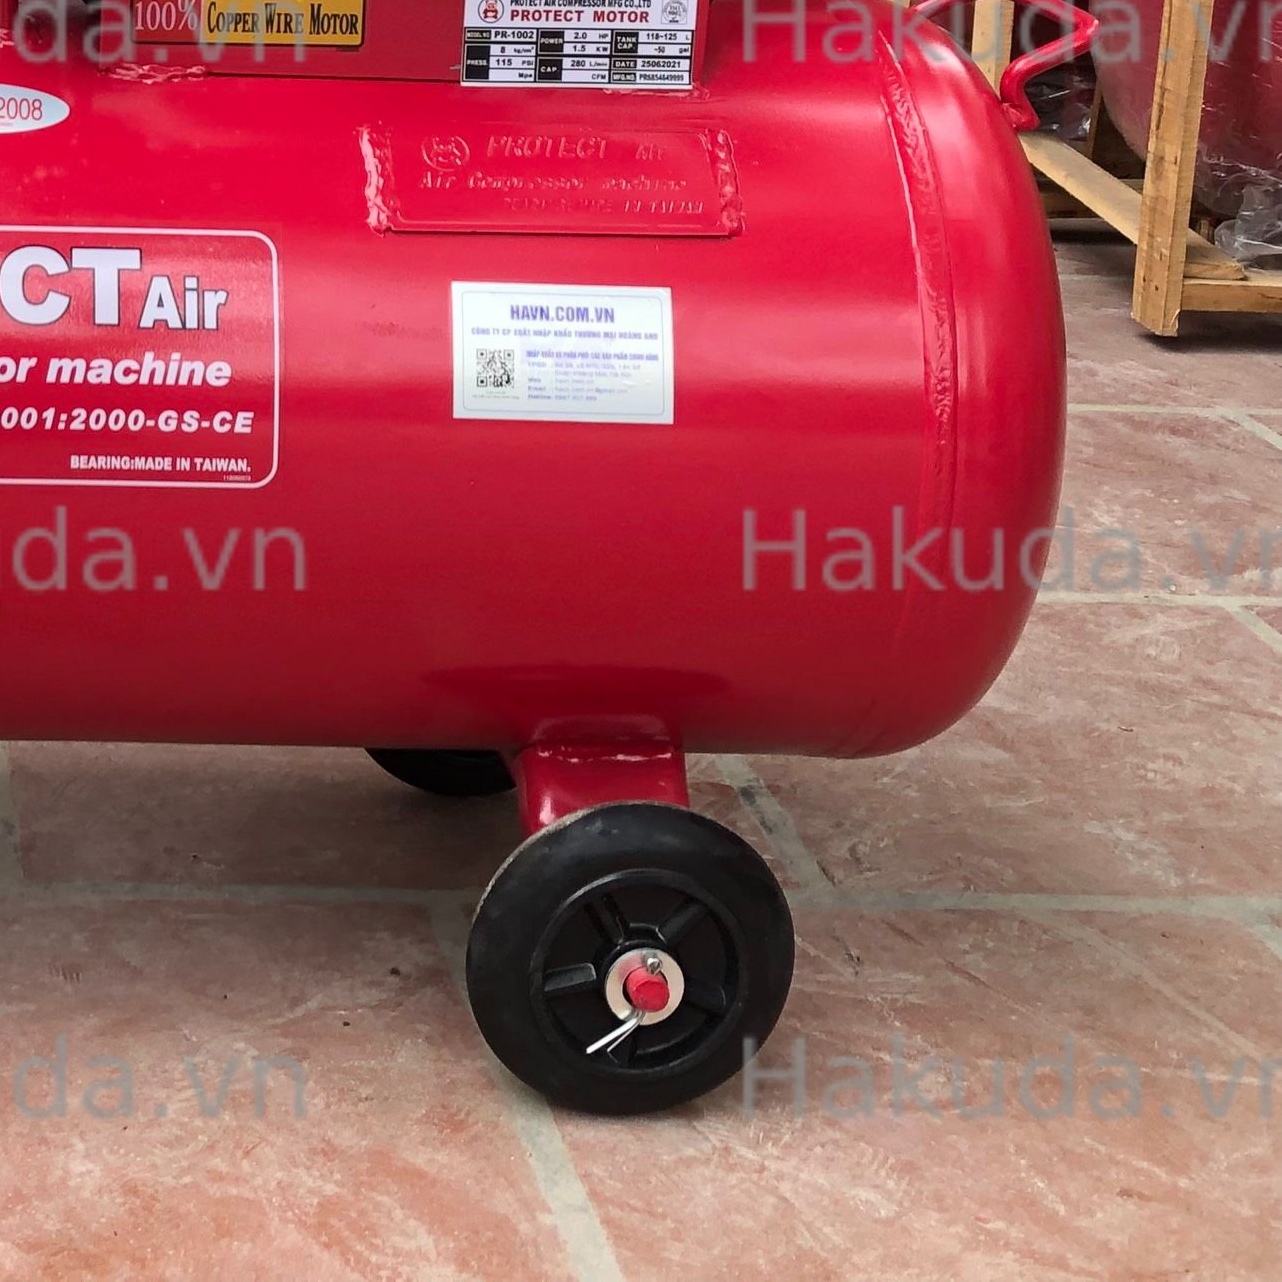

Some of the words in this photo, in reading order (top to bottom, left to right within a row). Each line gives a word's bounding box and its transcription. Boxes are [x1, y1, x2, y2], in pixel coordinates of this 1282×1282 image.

[607, 0, 623, 8] MFG
[207, 1, 260, 34] COPPER
[265, 2, 304, 34] WIRE
[309, 3, 359, 35] MOTOR
[510, 10, 585, 22] PROTECT
[593, 10, 650, 23] MOTOR
[494, 30, 535, 39] PR-1002
[574, 31, 588, 39] 2.0
[500, 46, 506, 54] 8
[495, 58, 513, 66] 115
[641, 60, 681, 68] 25062021
[486, 135, 607, 159] PROTECT
[139, 274, 228, 330] Air
[509, 304, 615, 324] HAVN.COM.VN
[46, 352, 232, 387] machine
[176, 456, 191, 471] IN
[194, 457, 252, 473] TAIWAN.
